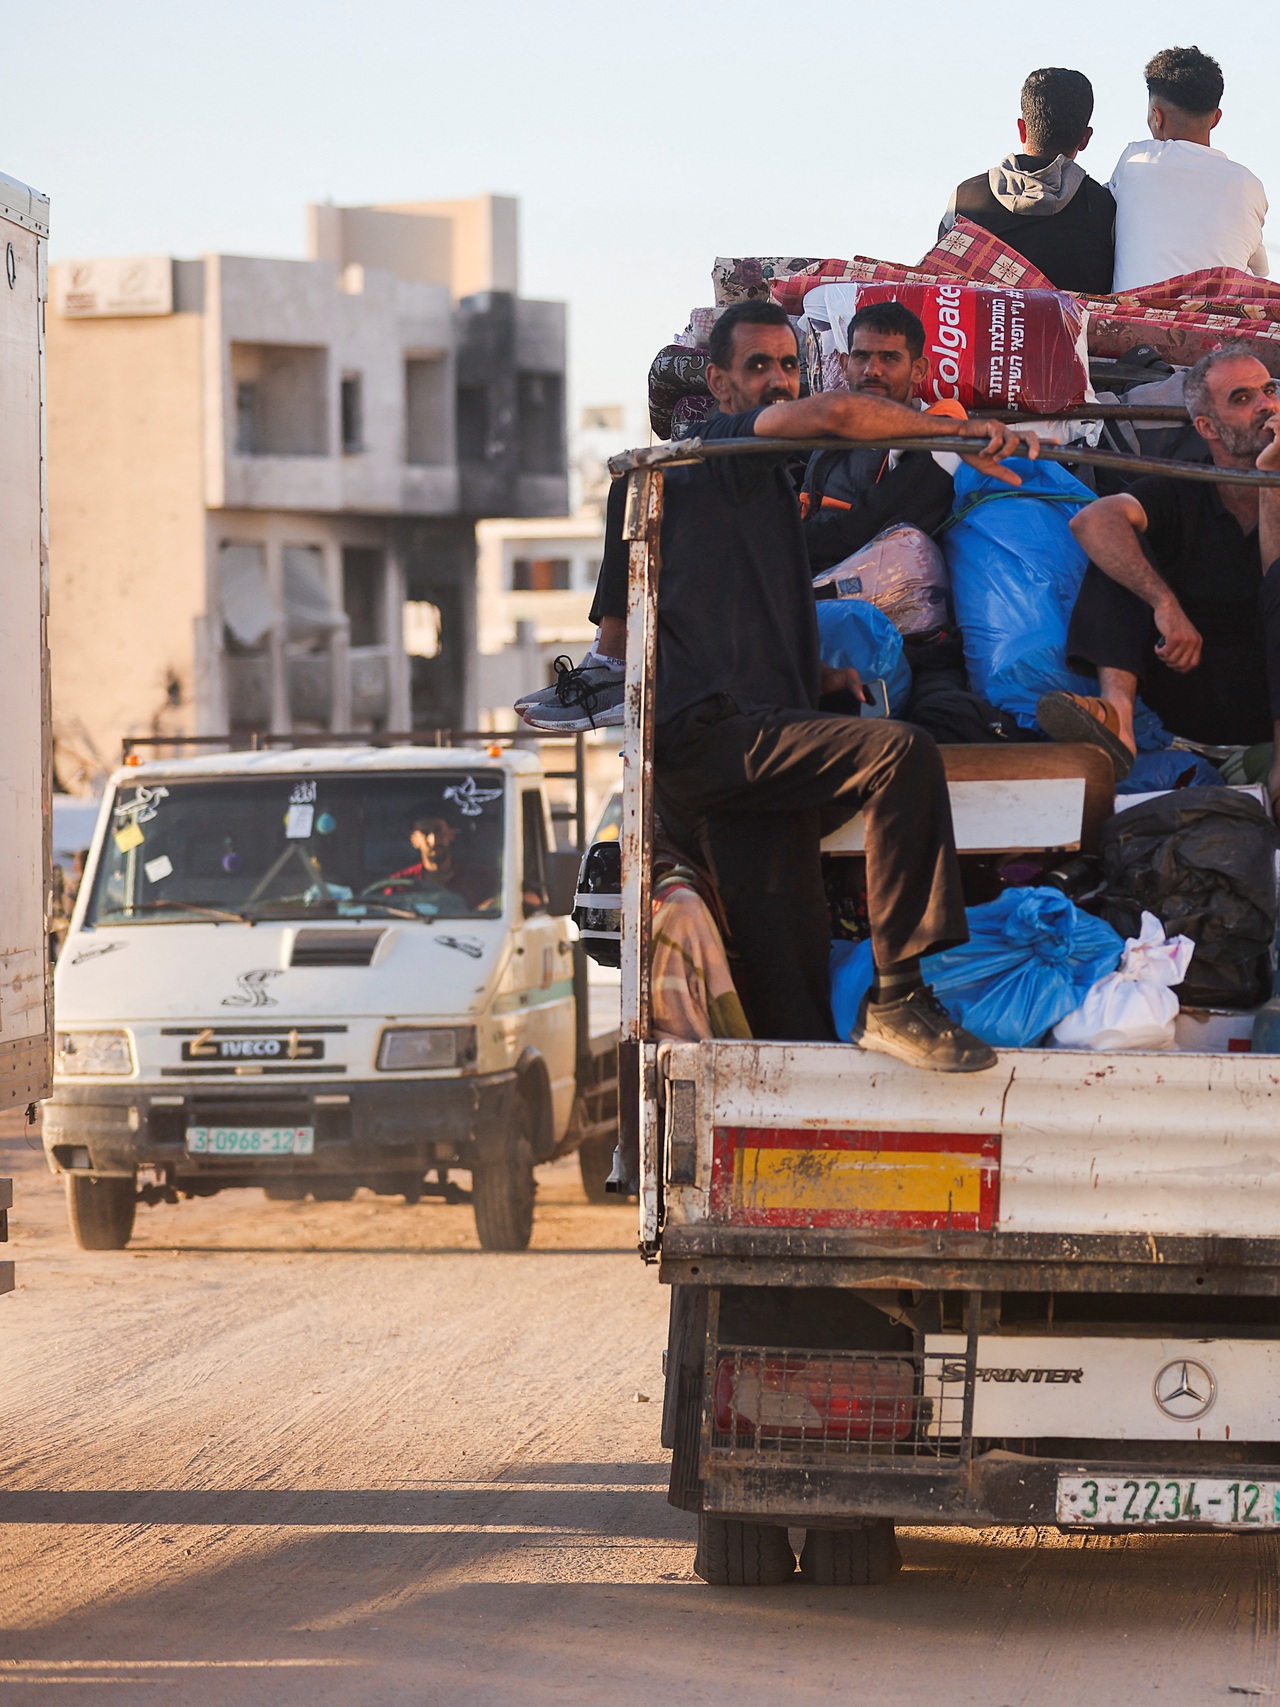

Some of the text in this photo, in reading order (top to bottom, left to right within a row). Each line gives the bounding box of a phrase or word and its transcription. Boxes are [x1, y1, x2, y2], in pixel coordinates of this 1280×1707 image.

[932, 286, 968, 401] Colgate
[989, 355, 1005, 398] ביותר
[220, 1039, 281, 1057] IVECO
[194, 1131, 294, 1151] 3-0968-12
[1081, 1479, 1261, 1523] 3-2234-12
